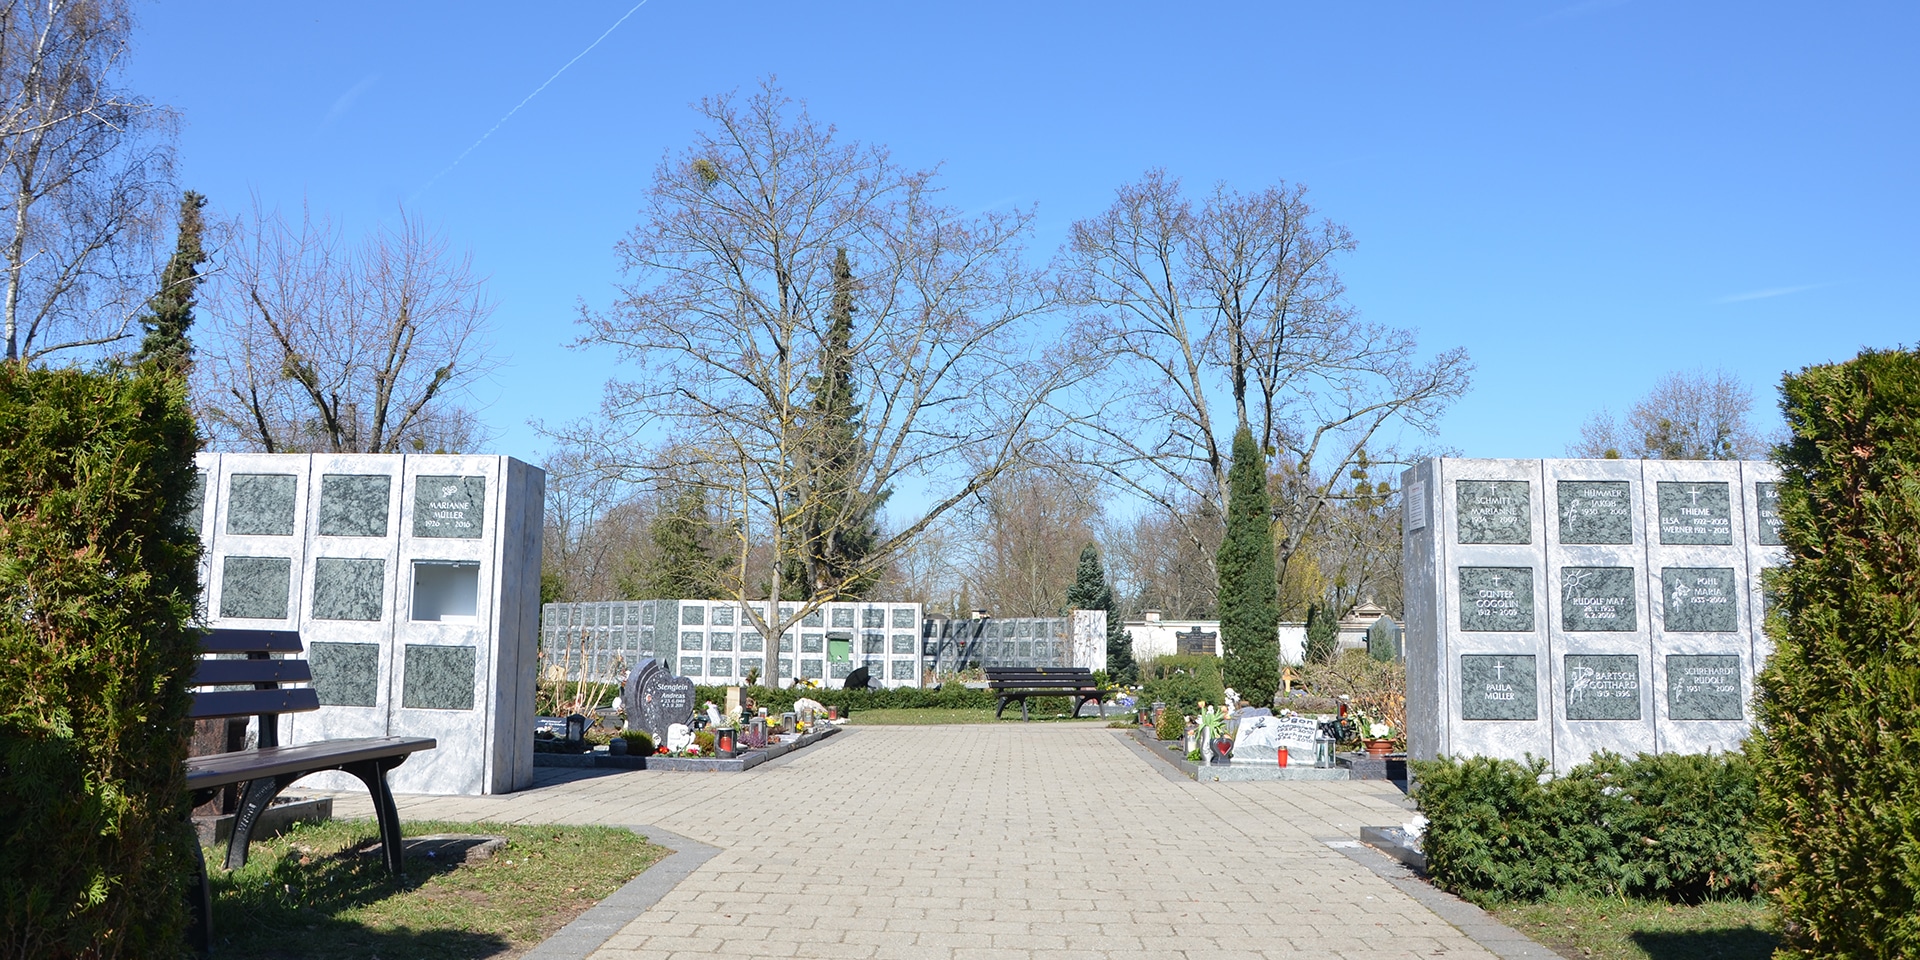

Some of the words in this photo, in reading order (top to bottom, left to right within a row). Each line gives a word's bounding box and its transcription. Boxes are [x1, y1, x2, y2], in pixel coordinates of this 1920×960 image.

[1765, 490, 1778, 498] BO
[1476, 496, 1510, 505] SCHMITT
[1591, 499, 1617, 507] JAKOB
[429, 502, 470, 510] MARIANNE
[432, 510, 464, 519] MÜLLER
[1471, 507, 1517, 515] MARIANNE
[1680, 507, 1711, 516] THIEME
[455, 520, 471, 528] 2016
[1662, 517, 1680, 525] ELSA
[1662, 526, 1694, 534] WERNER
[1694, 526, 1707, 534] 1921
[1697, 577, 1719, 586] POHL
[1694, 587, 1723, 596] MARIA
[1476, 599, 1519, 608] GOGOLIN
[1572, 597, 1605, 606] RUDOLF
[1605, 597, 1625, 606] MAY
[1595, 672, 1636, 681] BARTSCH
[1693, 676, 1726, 684] RUDOLF
[656, 683, 689, 692] Stenglein
[1486, 683, 1513, 692] PAULA
[1589, 680, 1638, 690] GOTTHARD
[1686, 685, 1701, 693] 1931
[1716, 685, 1735, 693] 2009
[1484, 691, 1515, 700] MÜLLER
[1280, 716, 1314, 725] Ogon
